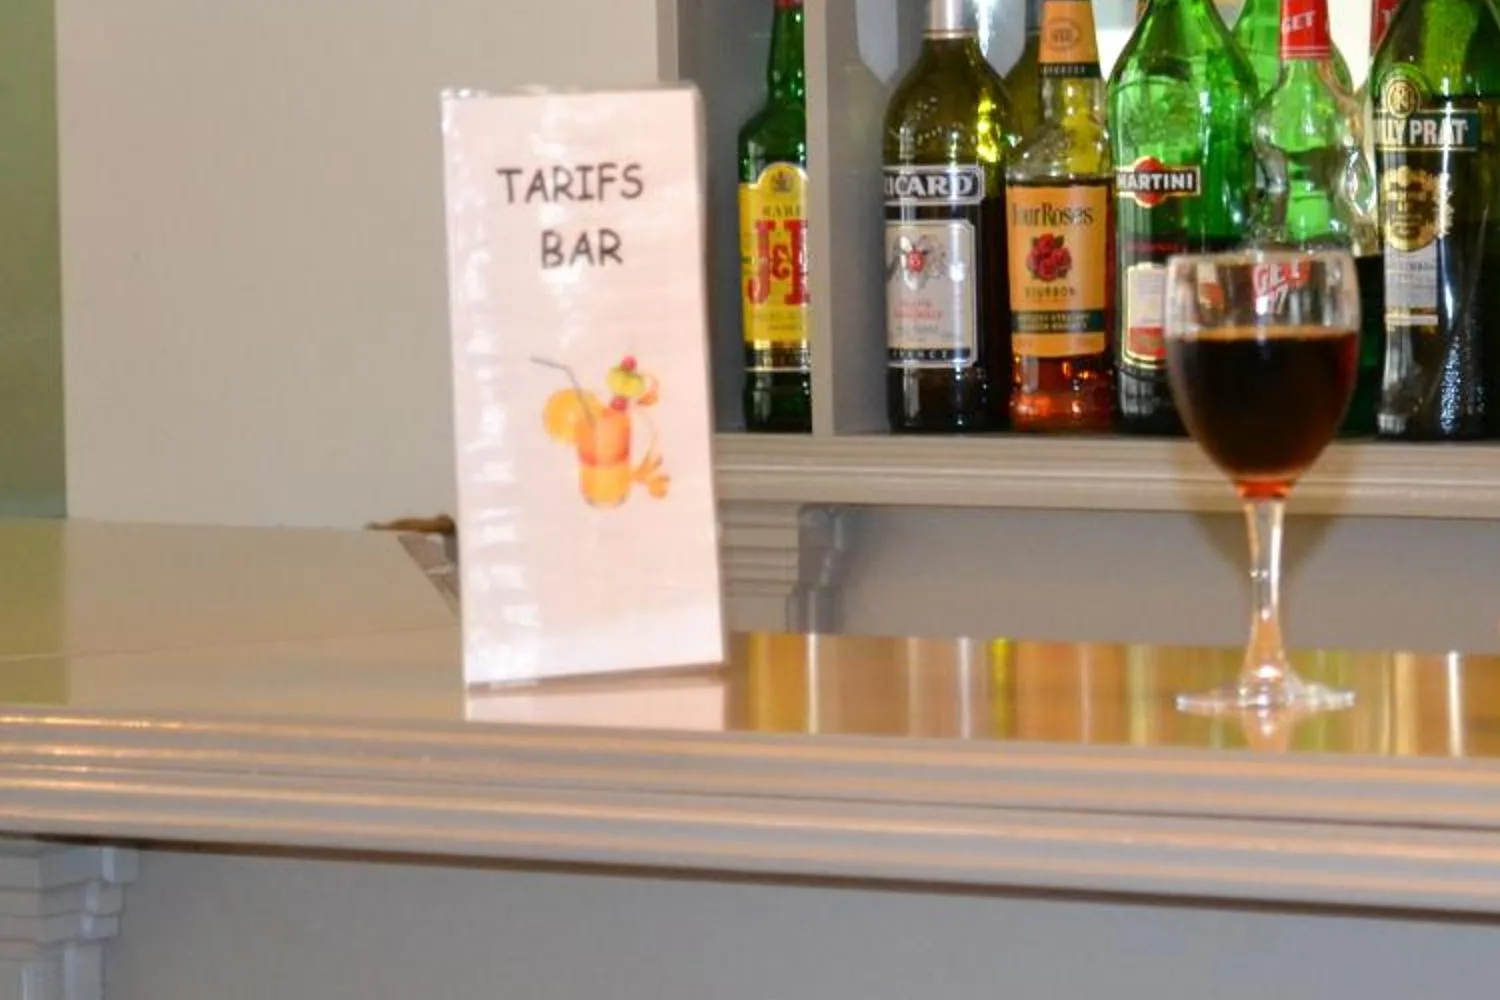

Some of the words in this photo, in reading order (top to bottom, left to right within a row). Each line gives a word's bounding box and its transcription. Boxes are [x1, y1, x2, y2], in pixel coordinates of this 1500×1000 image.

[1374, 118, 1407, 145] ILLY
[1409, 118, 1466, 146] PRAT
[496, 162, 645, 204] TARIFS
[1117, 172, 1194, 190] MARTINI
[1040, 201, 1094, 227] Roses
[539, 229, 624, 269] BAR
